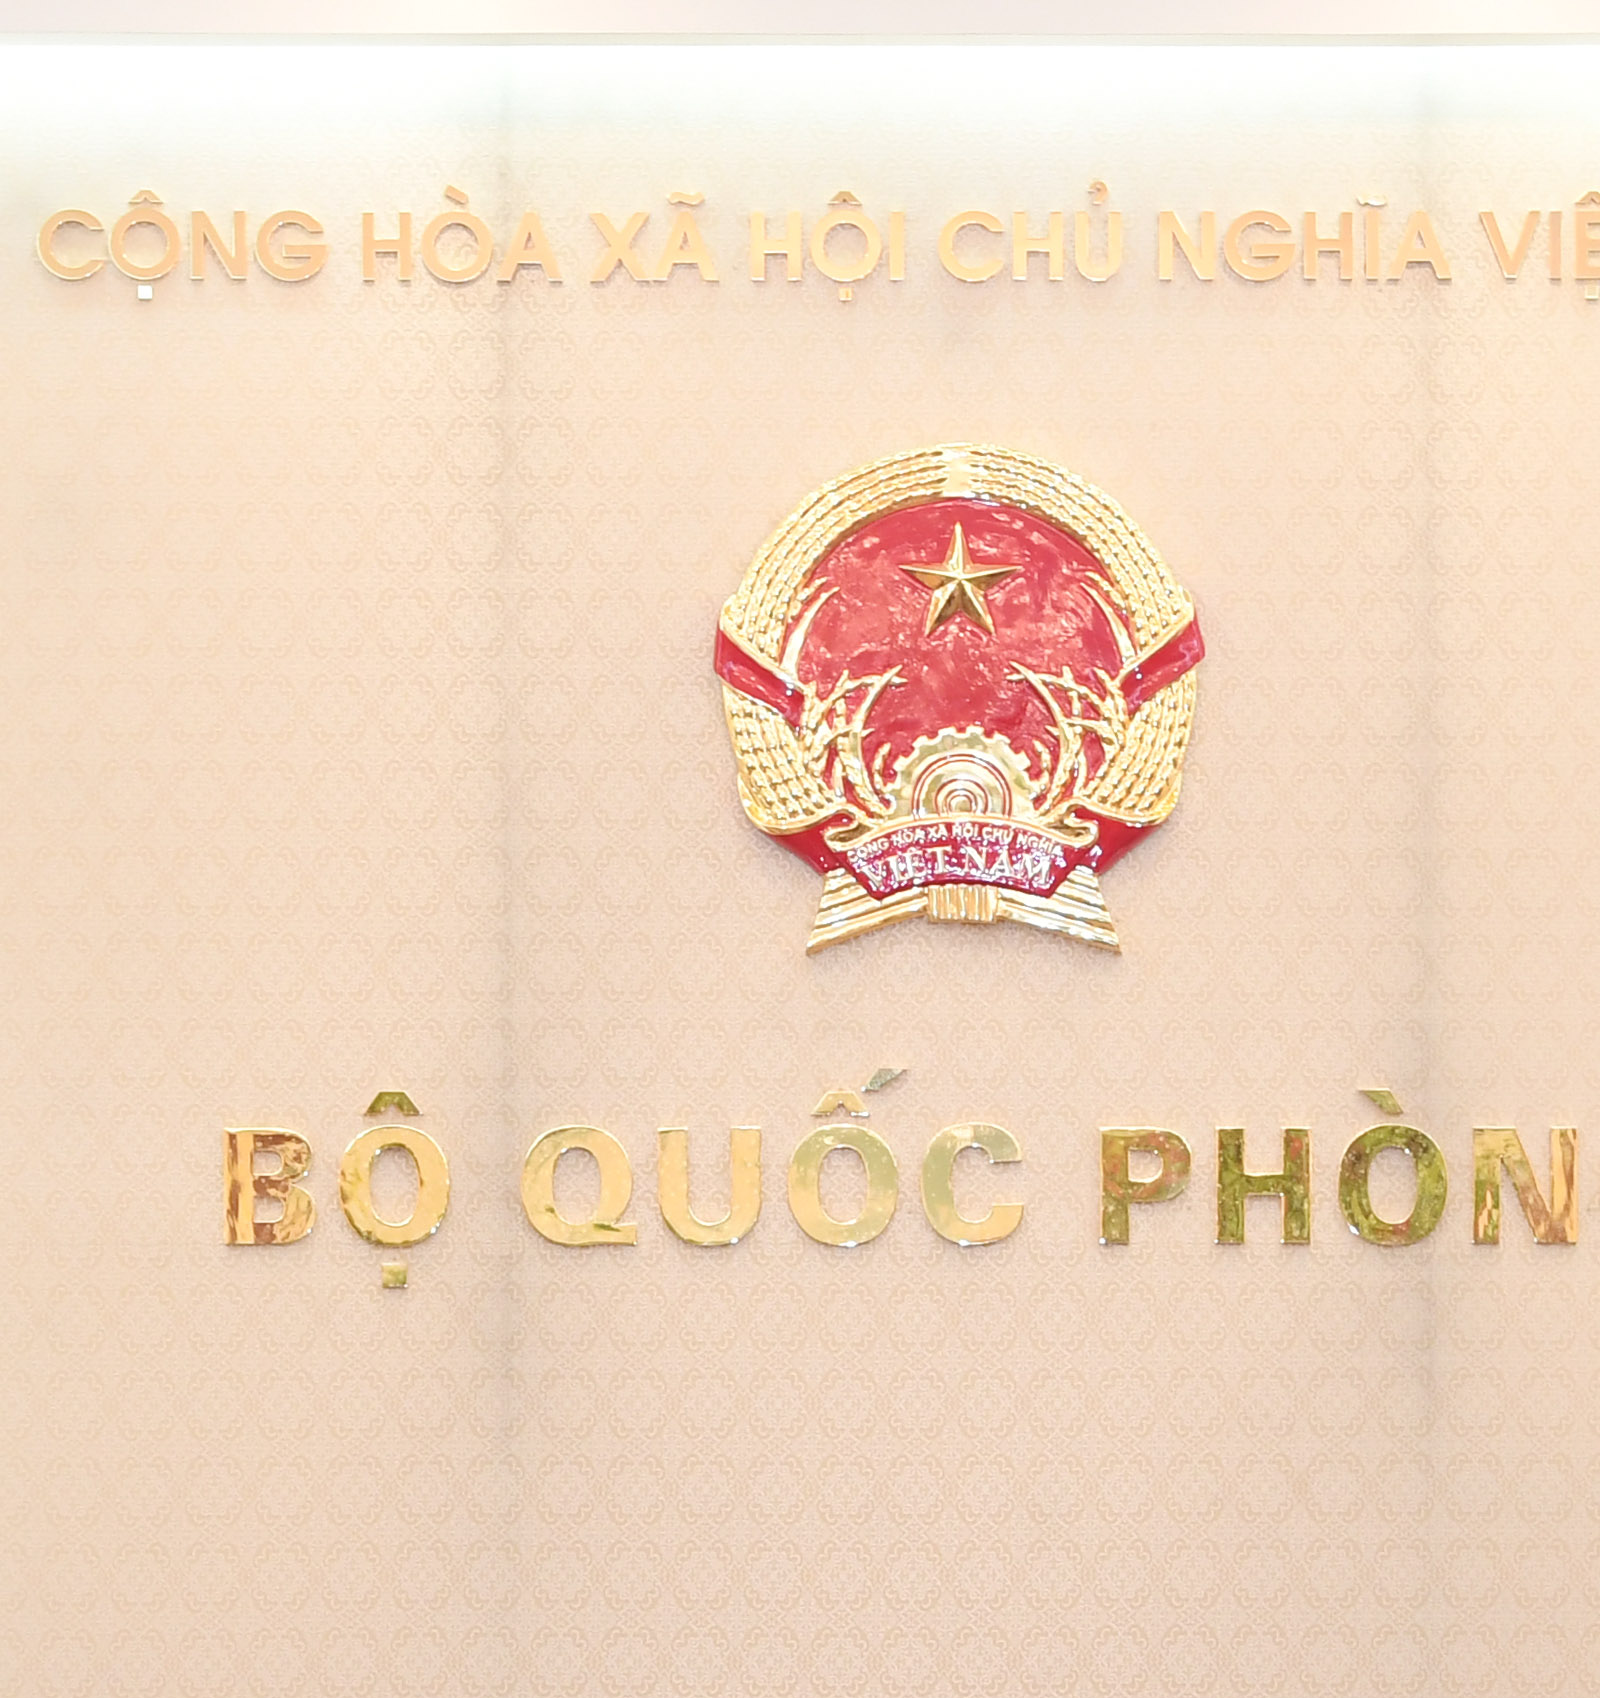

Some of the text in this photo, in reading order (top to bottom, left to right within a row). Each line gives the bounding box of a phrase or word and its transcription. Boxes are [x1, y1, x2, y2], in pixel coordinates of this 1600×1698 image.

[37, 188, 330, 301] CỘNG
[361, 184, 564, 283] HÒA
[589, 190, 720, 283] XÃ
[748, 190, 906, 302] HỘI
[937, 180, 1123, 283] CHỦ
[1157, 193, 1453, 283] NGHĨA
[960, 845, 1053, 886] NAM
[222, 1090, 453, 1289] BỘ
[519, 1067, 1026, 1248] QUỐC
